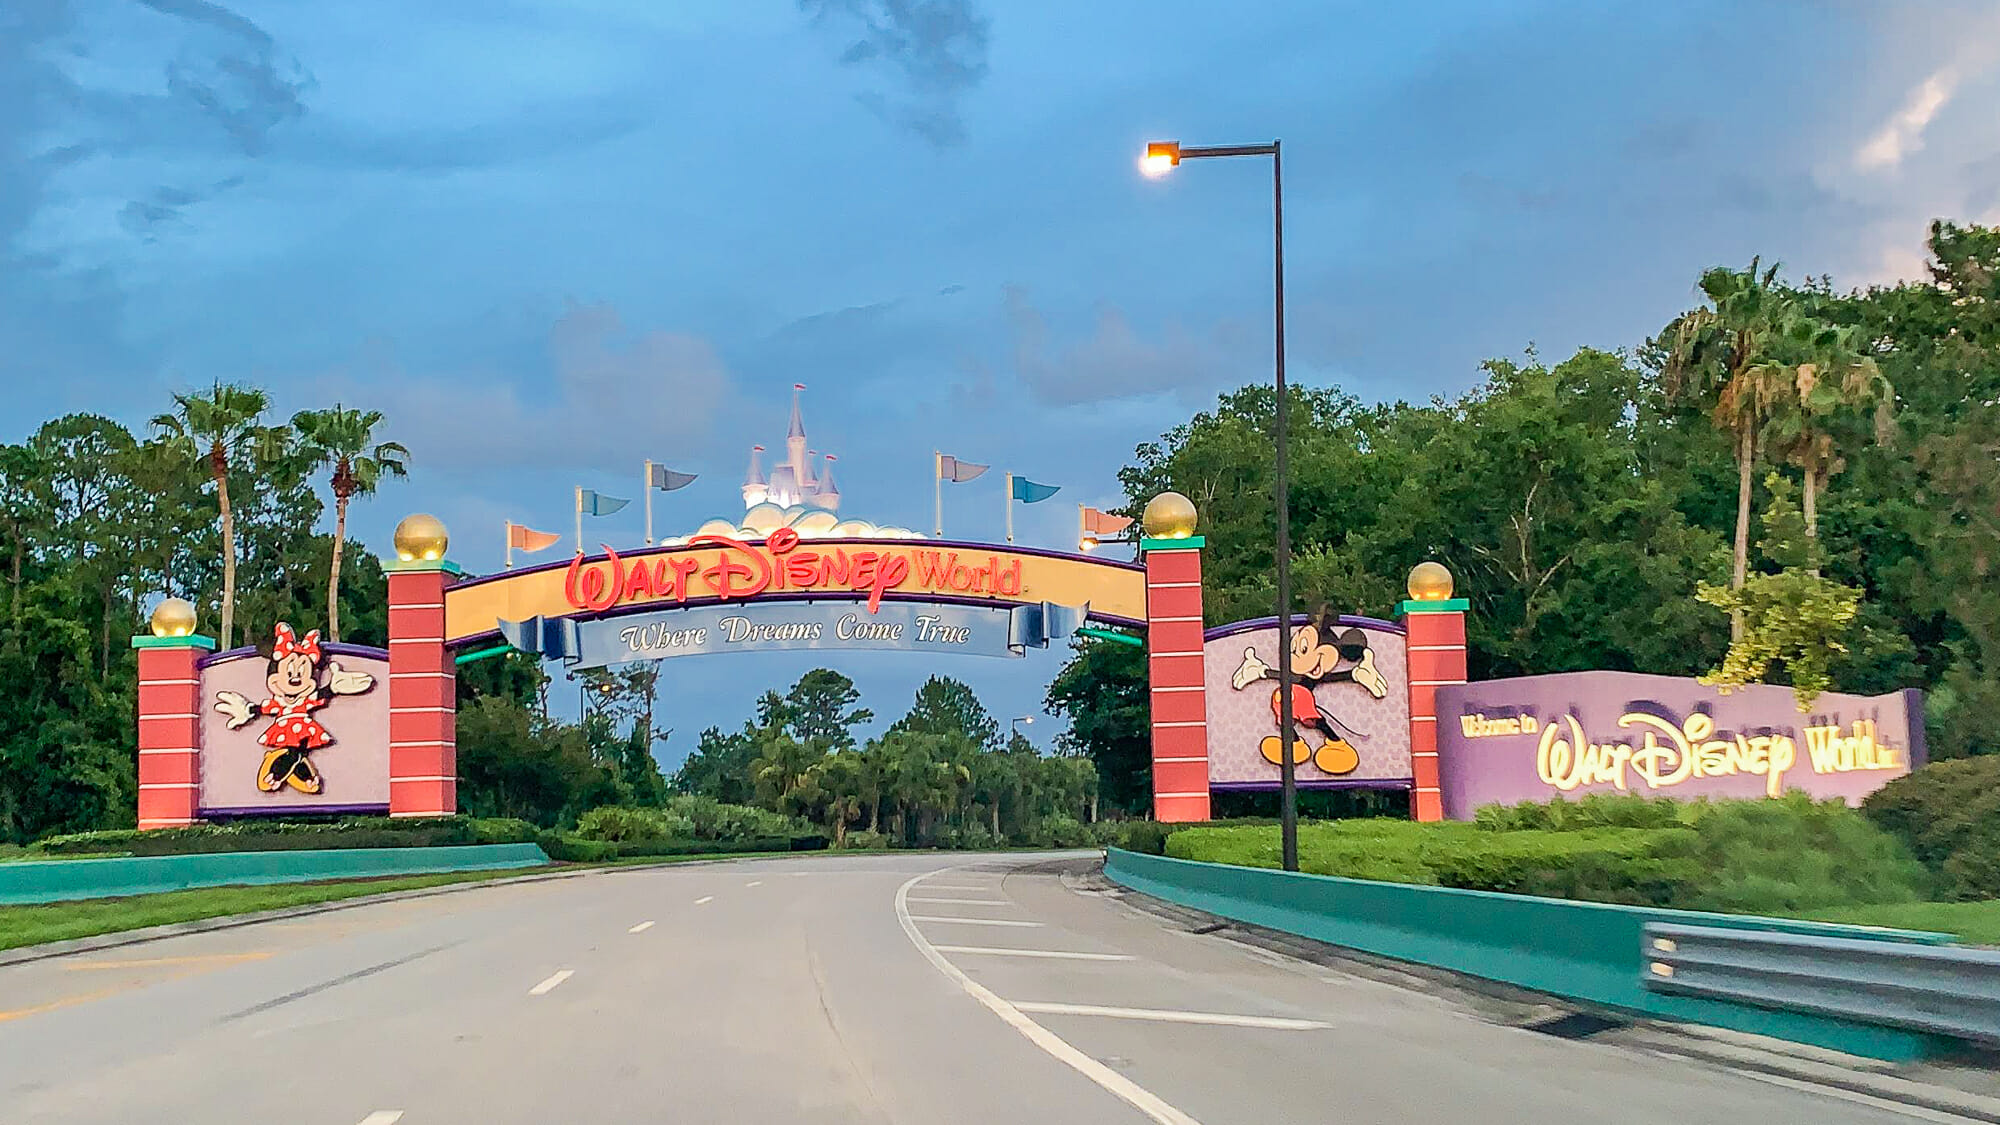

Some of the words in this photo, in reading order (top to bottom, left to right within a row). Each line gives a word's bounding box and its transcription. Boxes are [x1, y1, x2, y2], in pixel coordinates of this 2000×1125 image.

[911, 549, 1022, 595] World
[620, 621, 707, 652] Where
[719, 615, 823, 643] Dreams
[836, 613, 903, 641] Come
[915, 615, 970, 644] True
